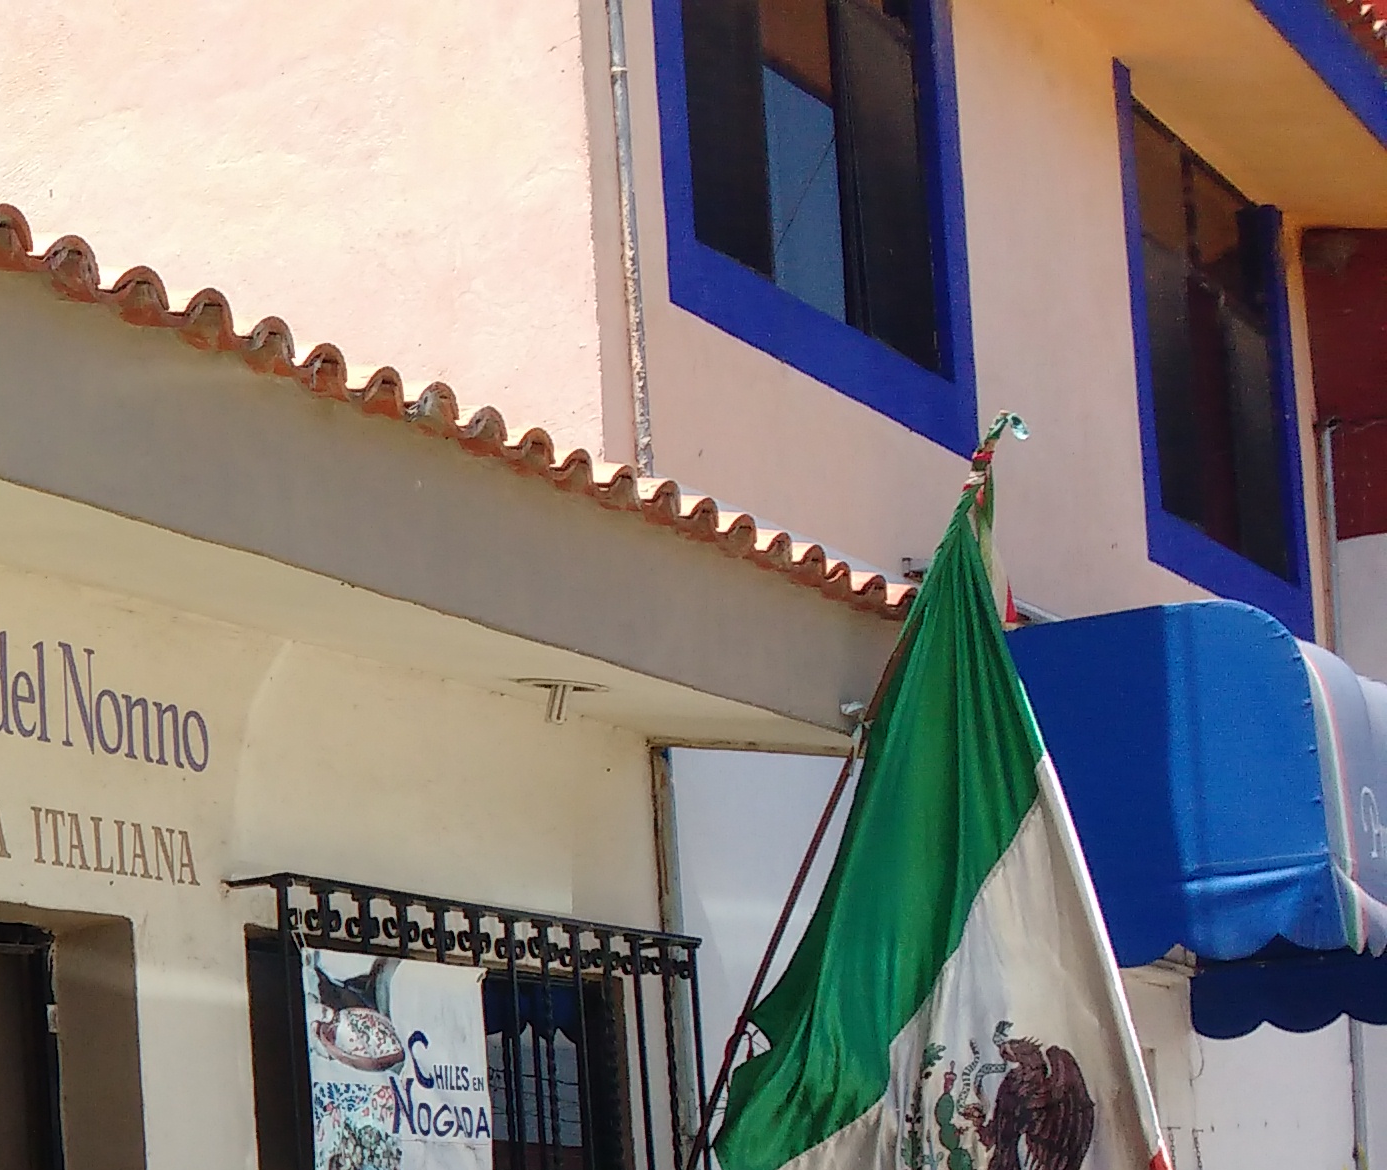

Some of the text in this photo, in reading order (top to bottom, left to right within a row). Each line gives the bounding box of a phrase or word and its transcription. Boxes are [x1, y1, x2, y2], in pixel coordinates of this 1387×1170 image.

[58, 641, 210, 773] Nonno
[29, 806, 201, 886] ITALIANA
[407, 1030, 485, 1092] CHILES EN
[389, 1076, 491, 1139] NOGADA
